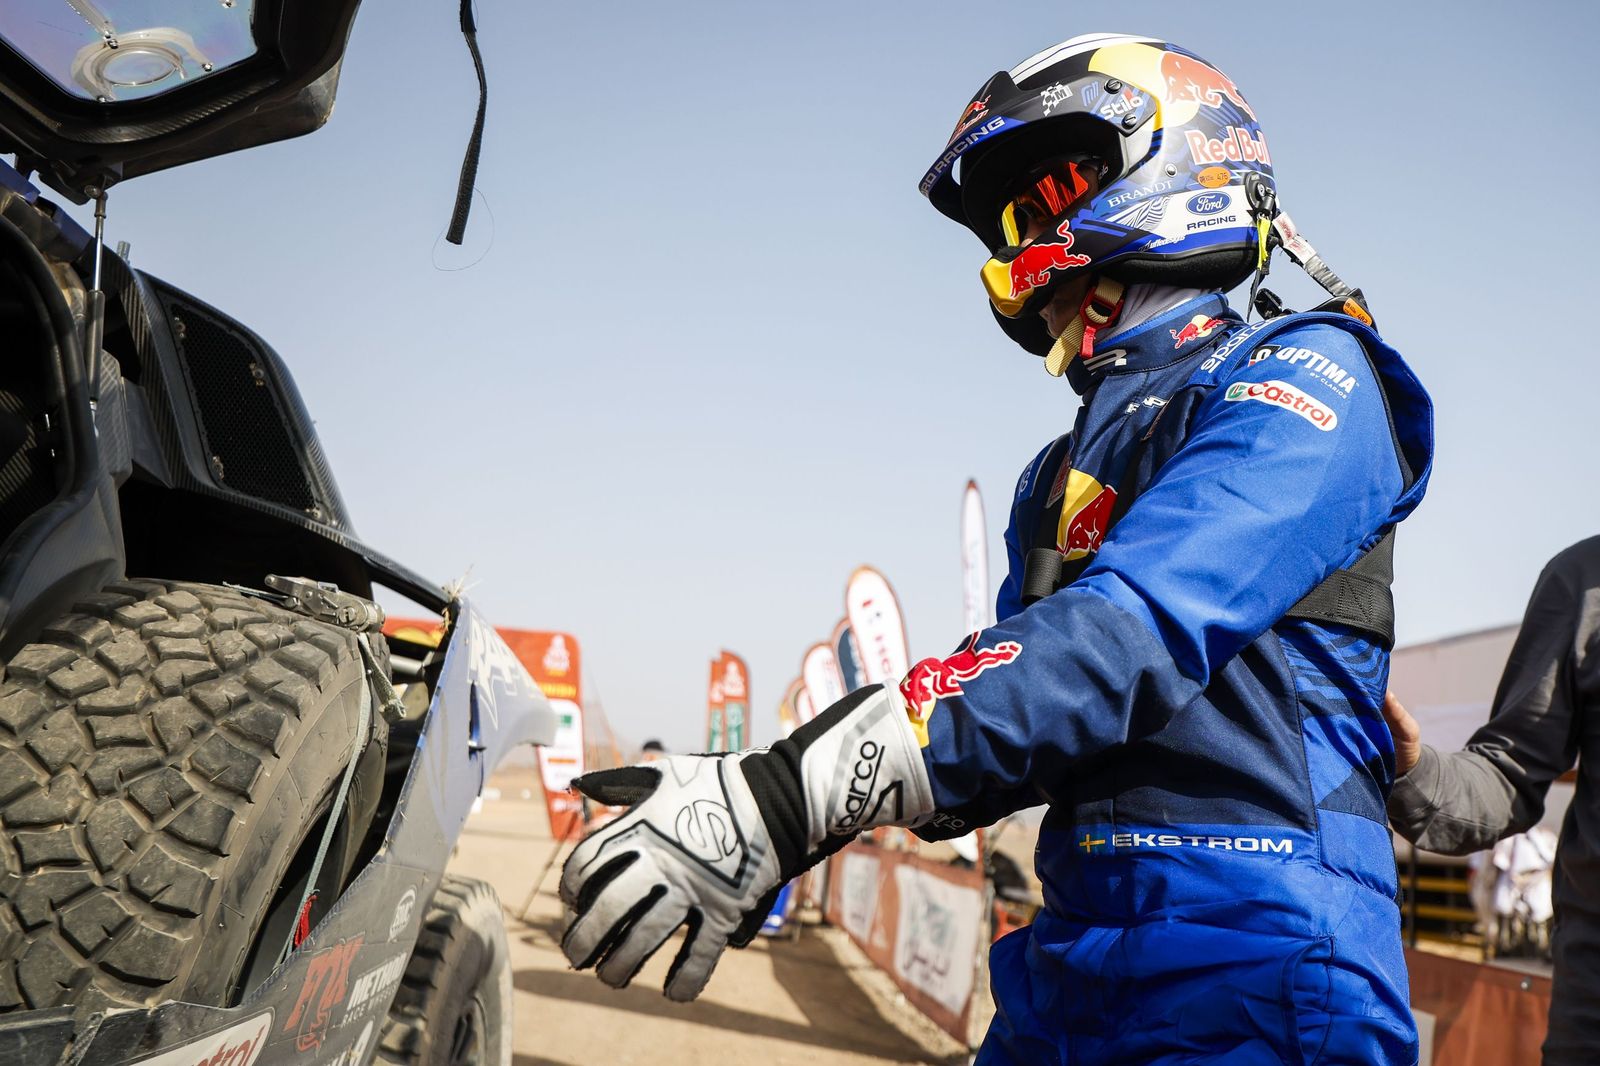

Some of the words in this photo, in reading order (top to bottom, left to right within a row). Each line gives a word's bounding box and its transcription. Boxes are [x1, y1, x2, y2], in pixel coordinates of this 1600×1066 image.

[1100, 90, 1144, 120] Stilo
[935, 116, 1006, 173] RACING
[1184, 126, 1243, 165] Red
[1235, 128, 1272, 167] Bul
[1108, 180, 1173, 208] BRANDT
[1196, 195, 1224, 211] Ford
[1187, 215, 1237, 230] RACING
[1275, 347, 1357, 394] OPTIMA
[1320, 377, 1347, 400] CLARIOS
[1248, 383, 1333, 426] Castrol
[1112, 833, 1293, 854] EKSTROM
